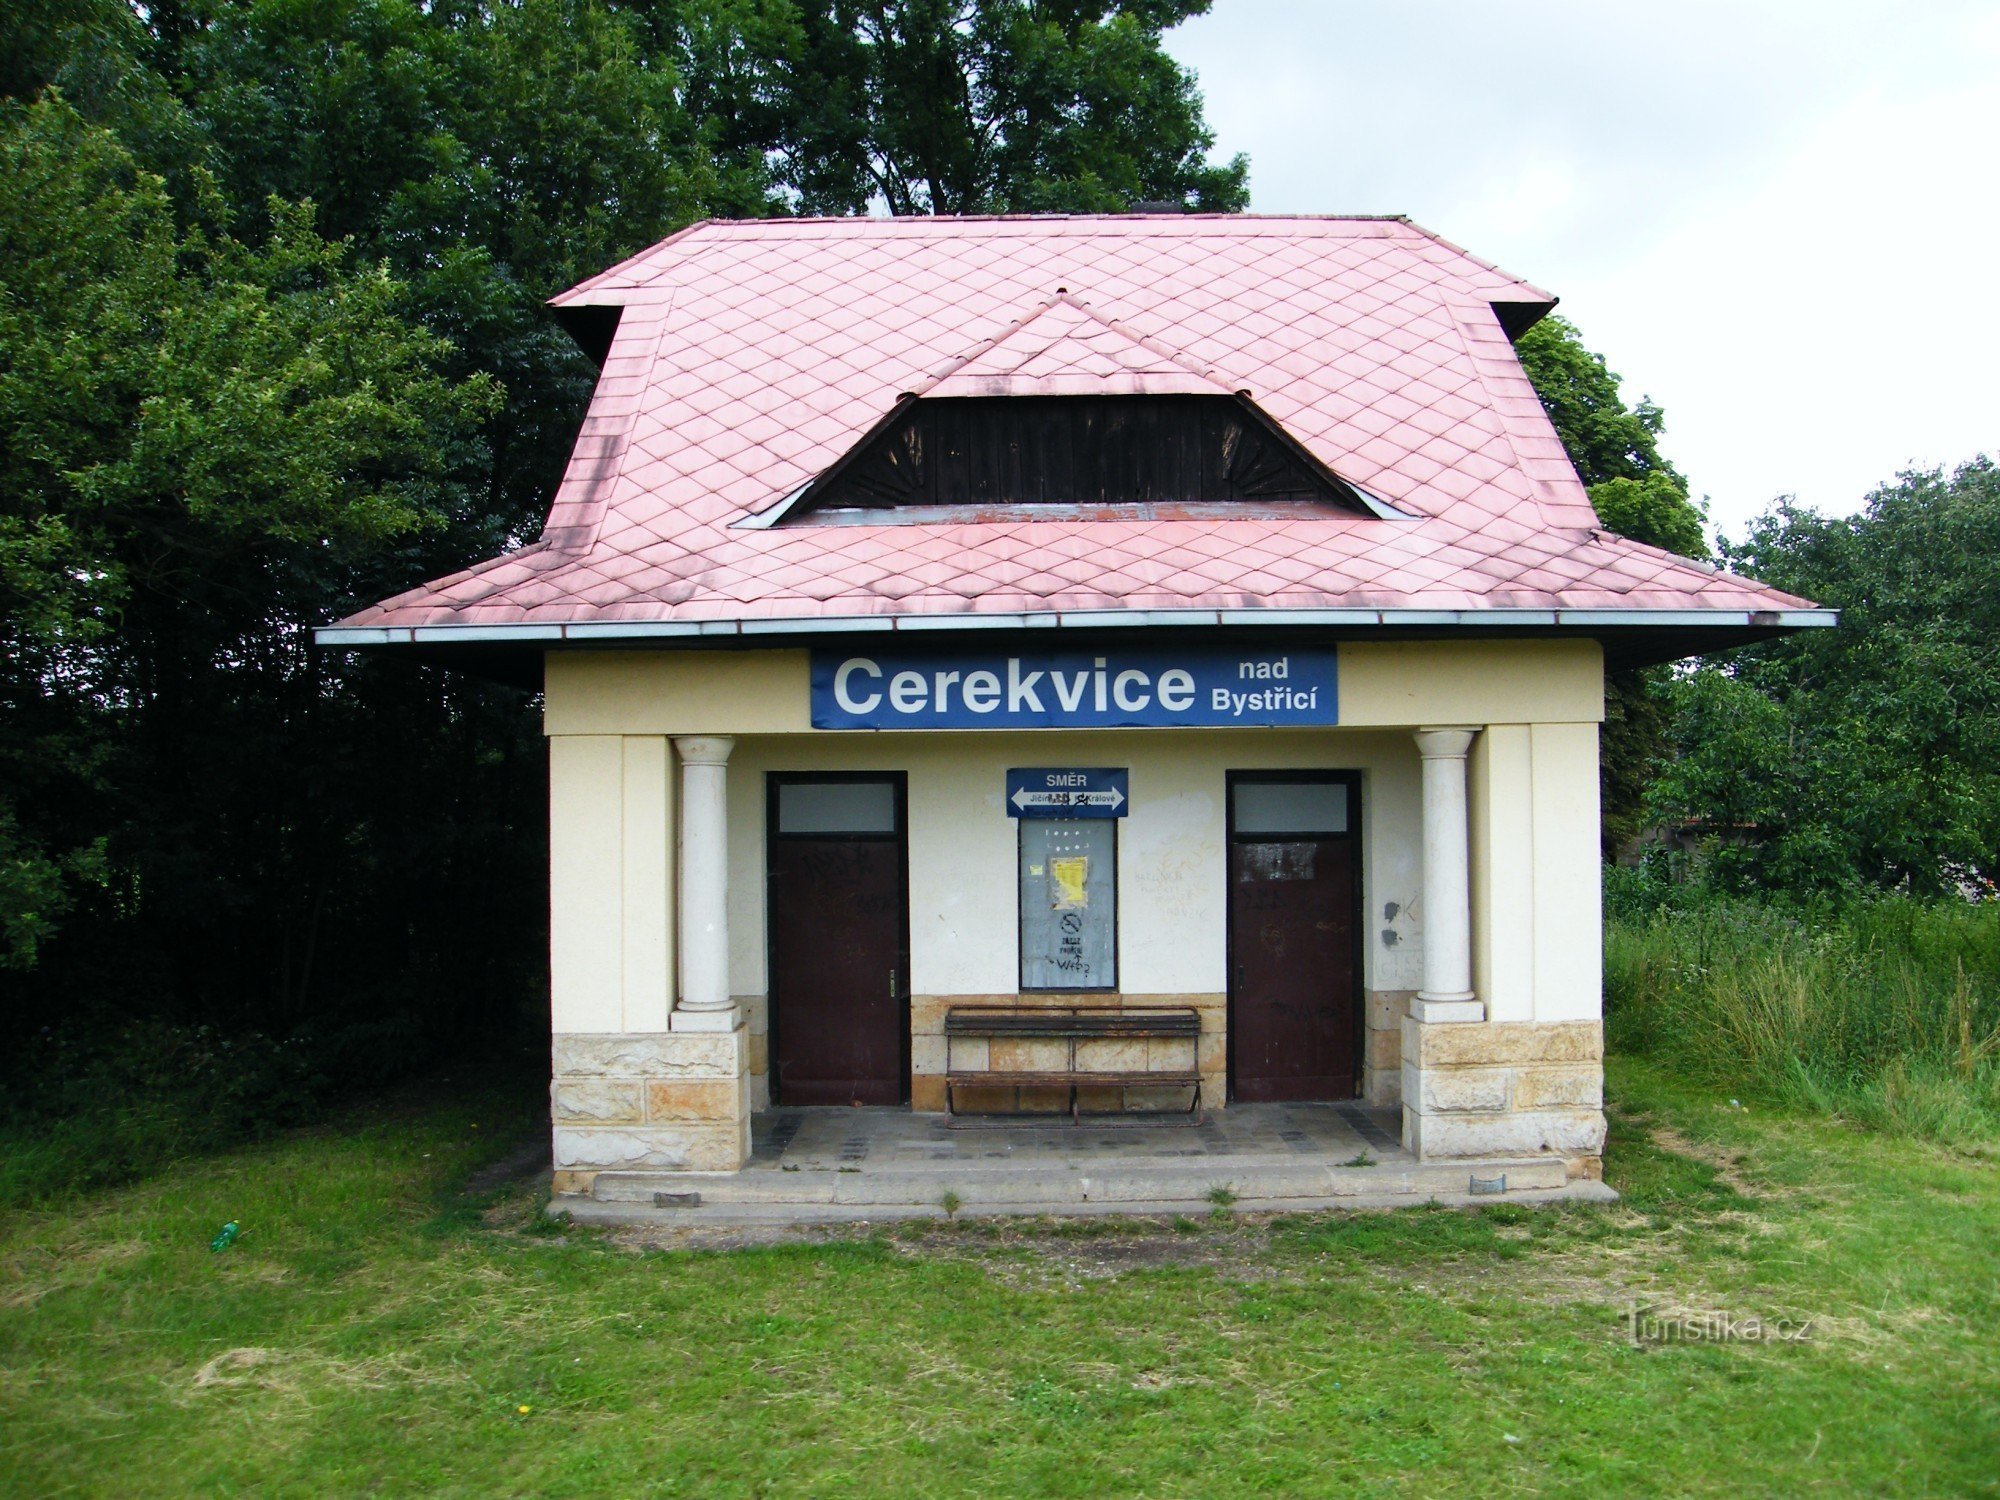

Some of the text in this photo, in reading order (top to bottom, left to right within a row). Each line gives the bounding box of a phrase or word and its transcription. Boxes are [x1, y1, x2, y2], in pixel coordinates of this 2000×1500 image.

[1239, 656, 1289, 680] nad
[833, 656, 1196, 715] Cerekvice
[1211, 685, 1318, 716] Bystřicí
[1046, 771, 1087, 787] SMĚR
